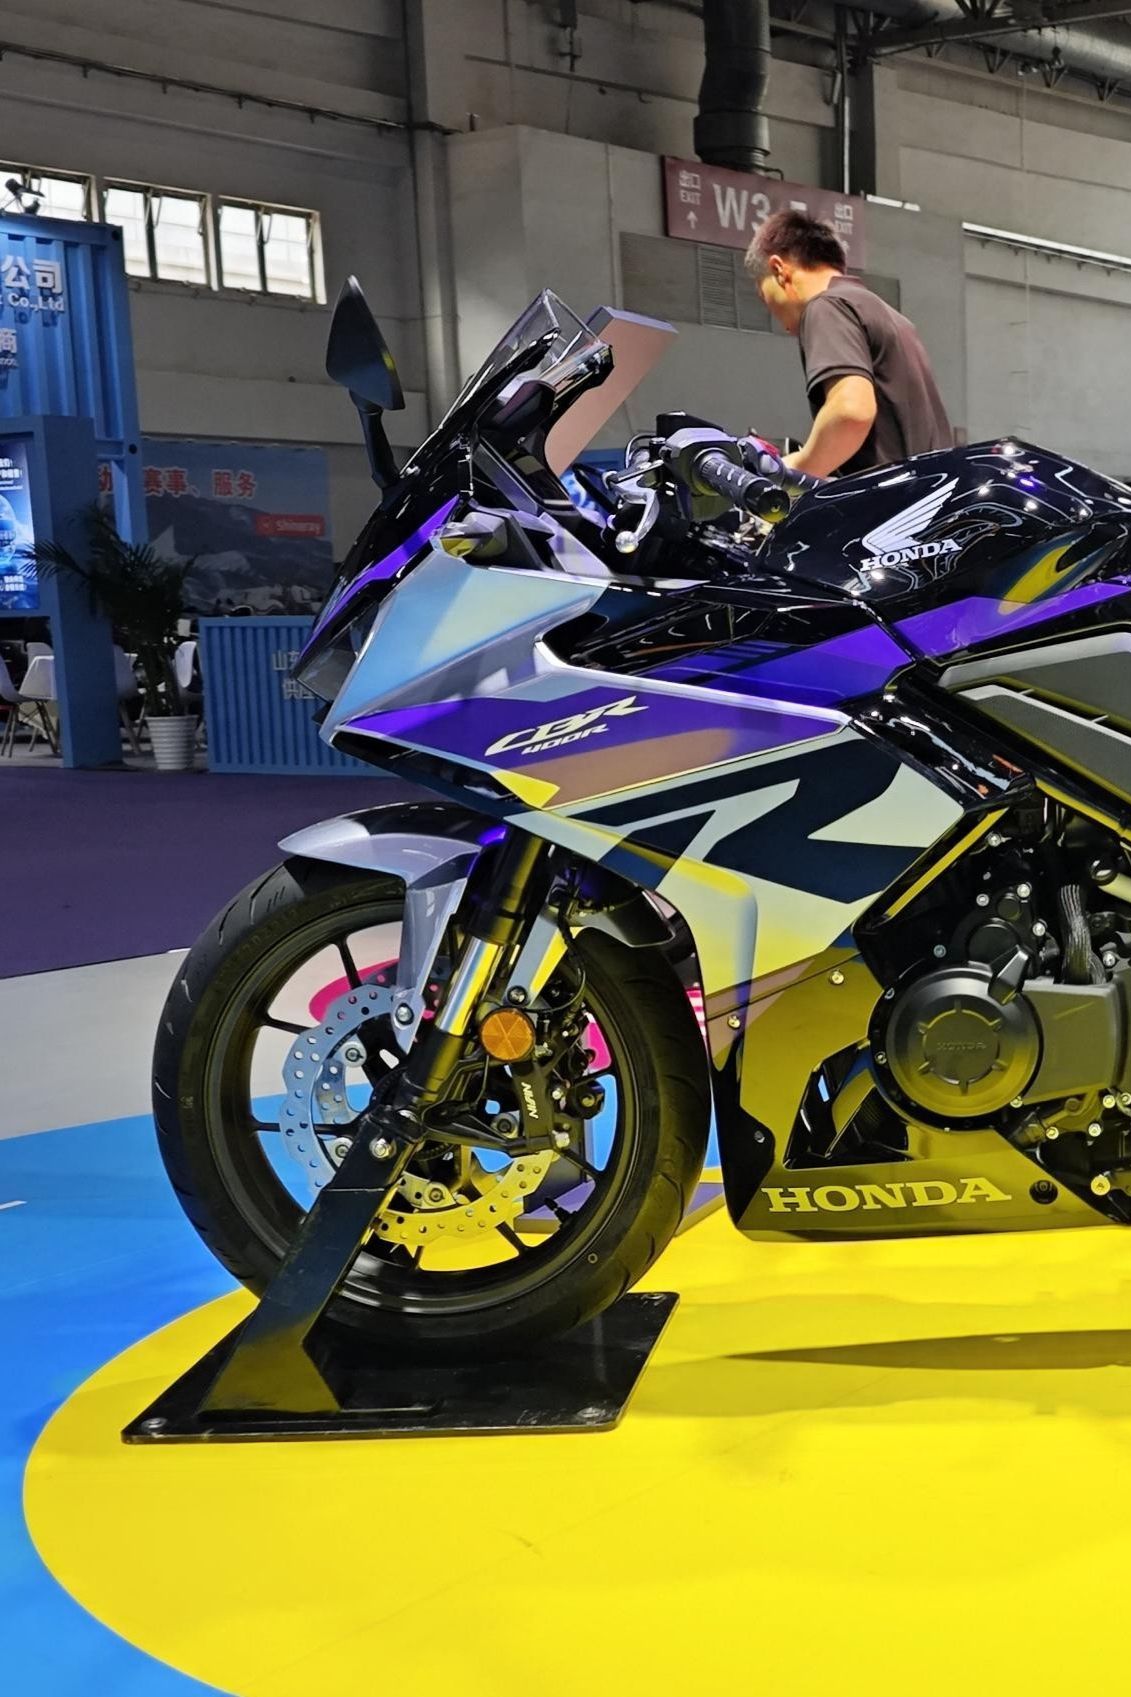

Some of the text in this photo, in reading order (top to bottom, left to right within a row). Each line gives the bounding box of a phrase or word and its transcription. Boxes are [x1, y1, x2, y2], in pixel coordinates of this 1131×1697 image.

[680, 189, 701, 205] EXIT
[0, 255, 62, 294] 公司
[860, 538, 962, 572] HONDA
[484, 696, 649, 756] CBR
[521, 724, 609, 755] 400R
[761, 1177, 1012, 1212] HONDA
